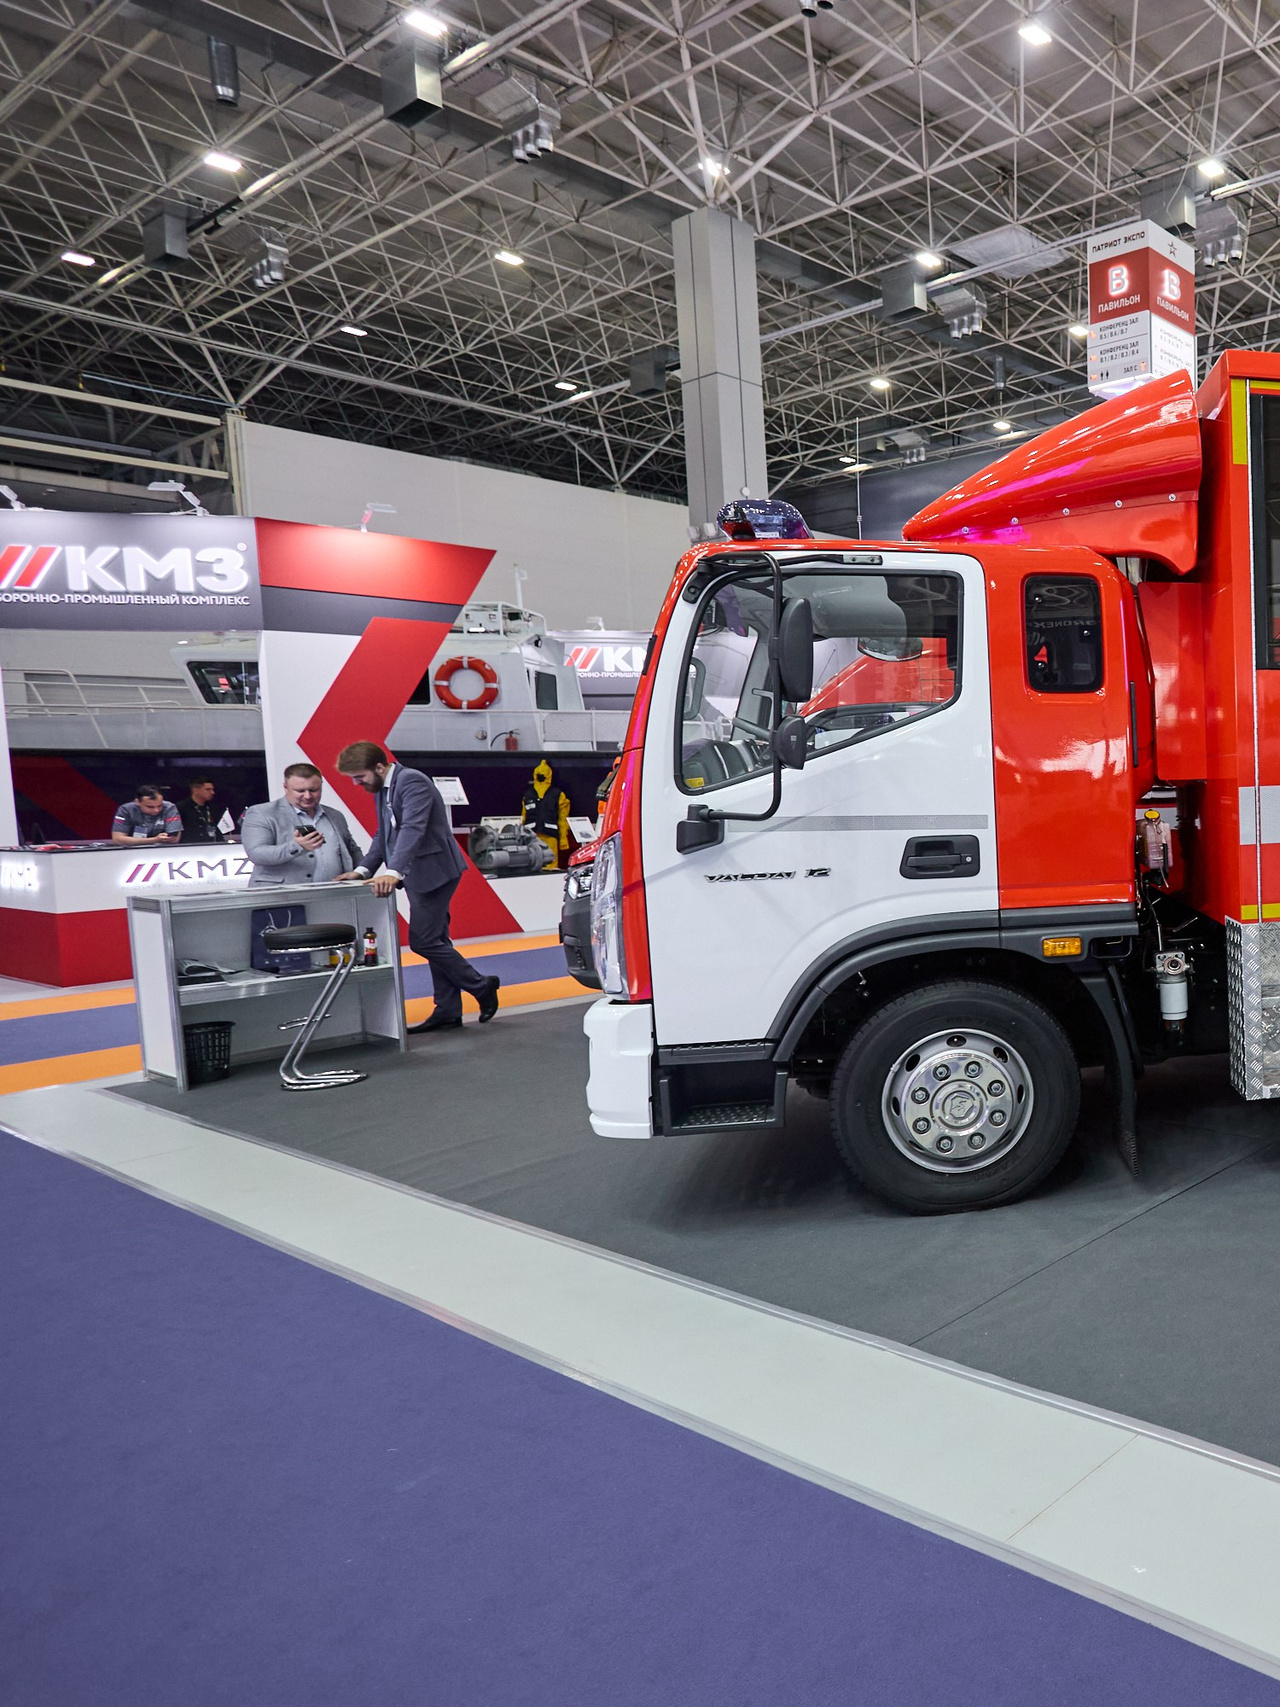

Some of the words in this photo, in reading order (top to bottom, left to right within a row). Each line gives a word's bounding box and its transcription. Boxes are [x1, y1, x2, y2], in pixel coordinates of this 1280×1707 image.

[1092, 238, 1121, 253] ПАТРИОТ
[1124, 231, 1145, 243] ЭКСПО
[1109, 265, 1128, 296] В
[1163, 269, 1181, 300] В
[1098, 294, 1141, 313] ПАВИЛЬОН
[1156, 296, 1189, 321] ПАВИЛЬОН
[65, 545, 249, 594] КМЗ
[0, 593, 180, 605] ОРОННО-ПРОМЫШЛЕННЫЙ
[182, 595, 250, 606] КОМПЛЕКС
